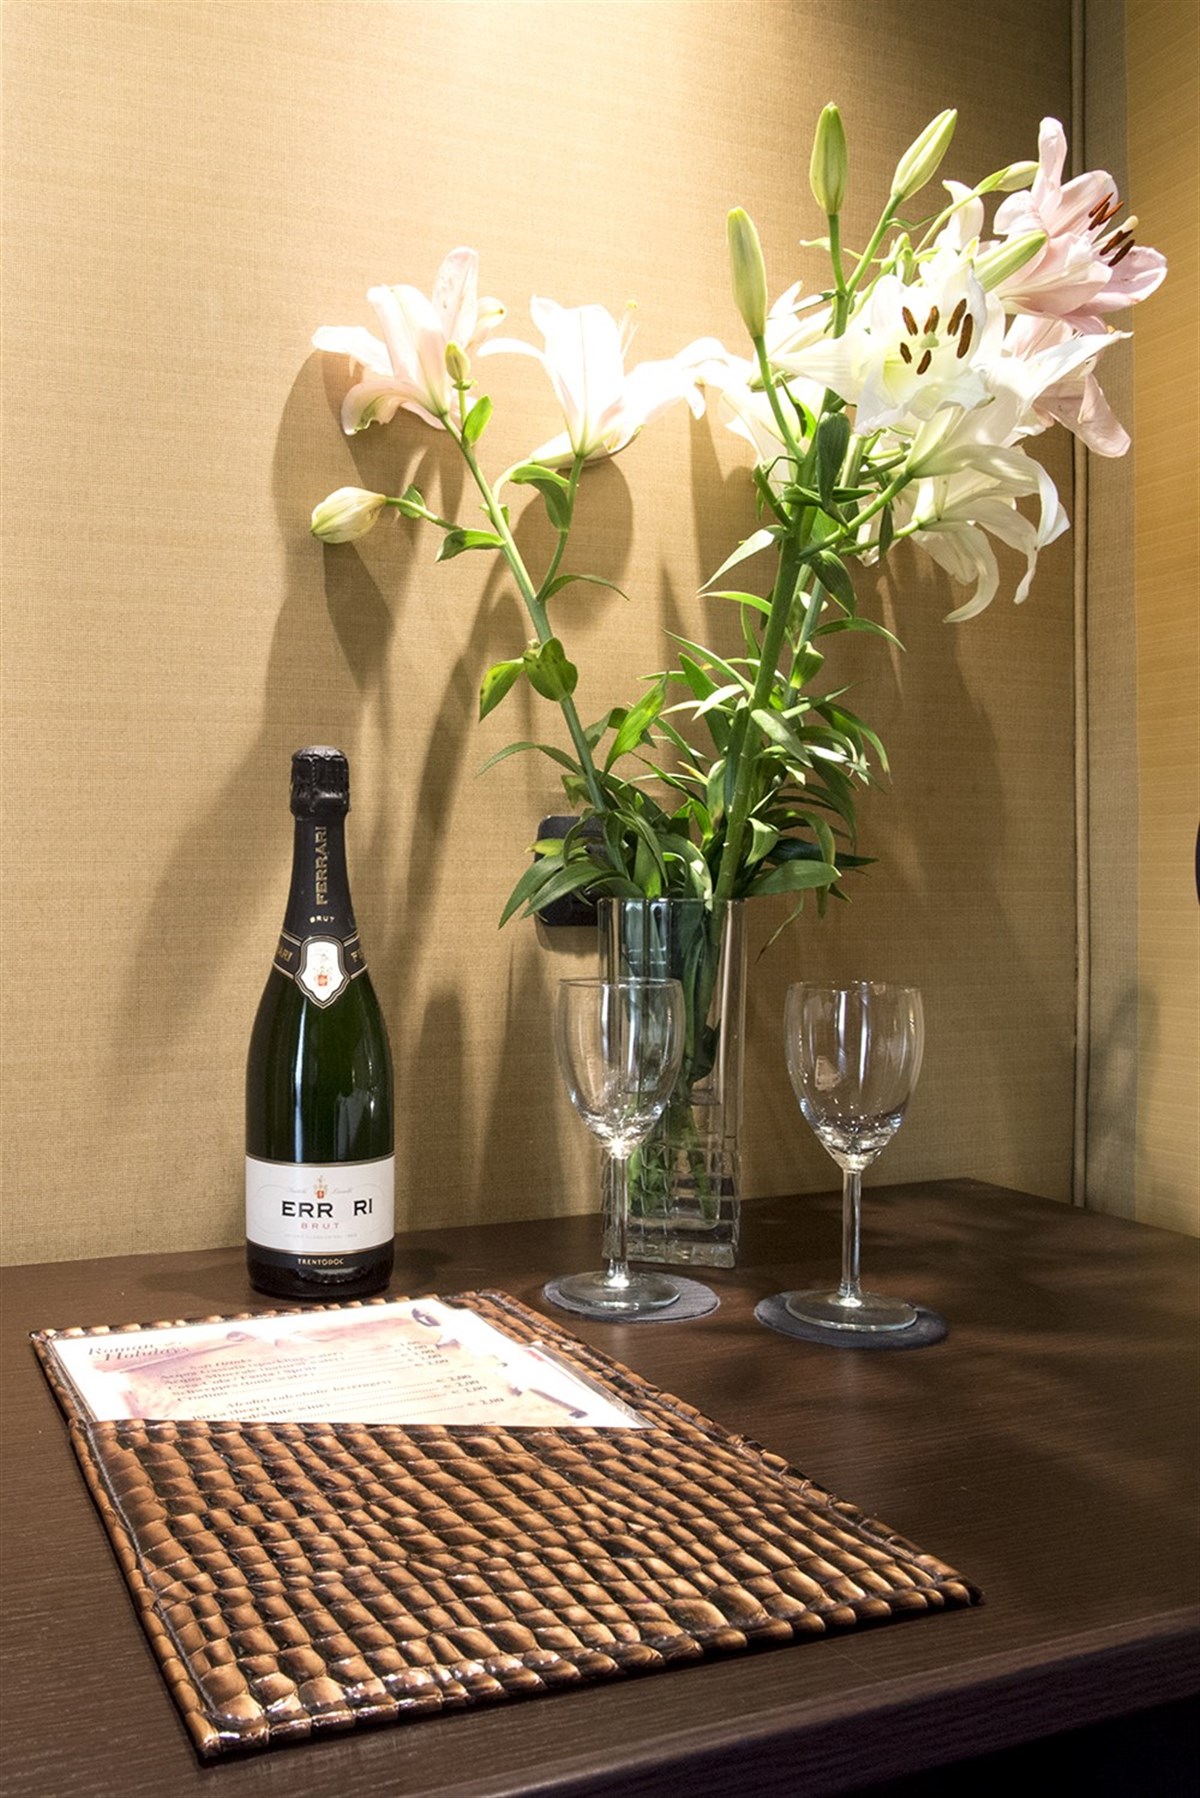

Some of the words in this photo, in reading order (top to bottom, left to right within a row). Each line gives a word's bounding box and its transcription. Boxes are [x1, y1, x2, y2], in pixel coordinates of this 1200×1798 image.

[314, 825, 328, 906] FERRARI
[309, 915, 335, 924] BRUT
[300, 1222, 340, 1230] BRUT
